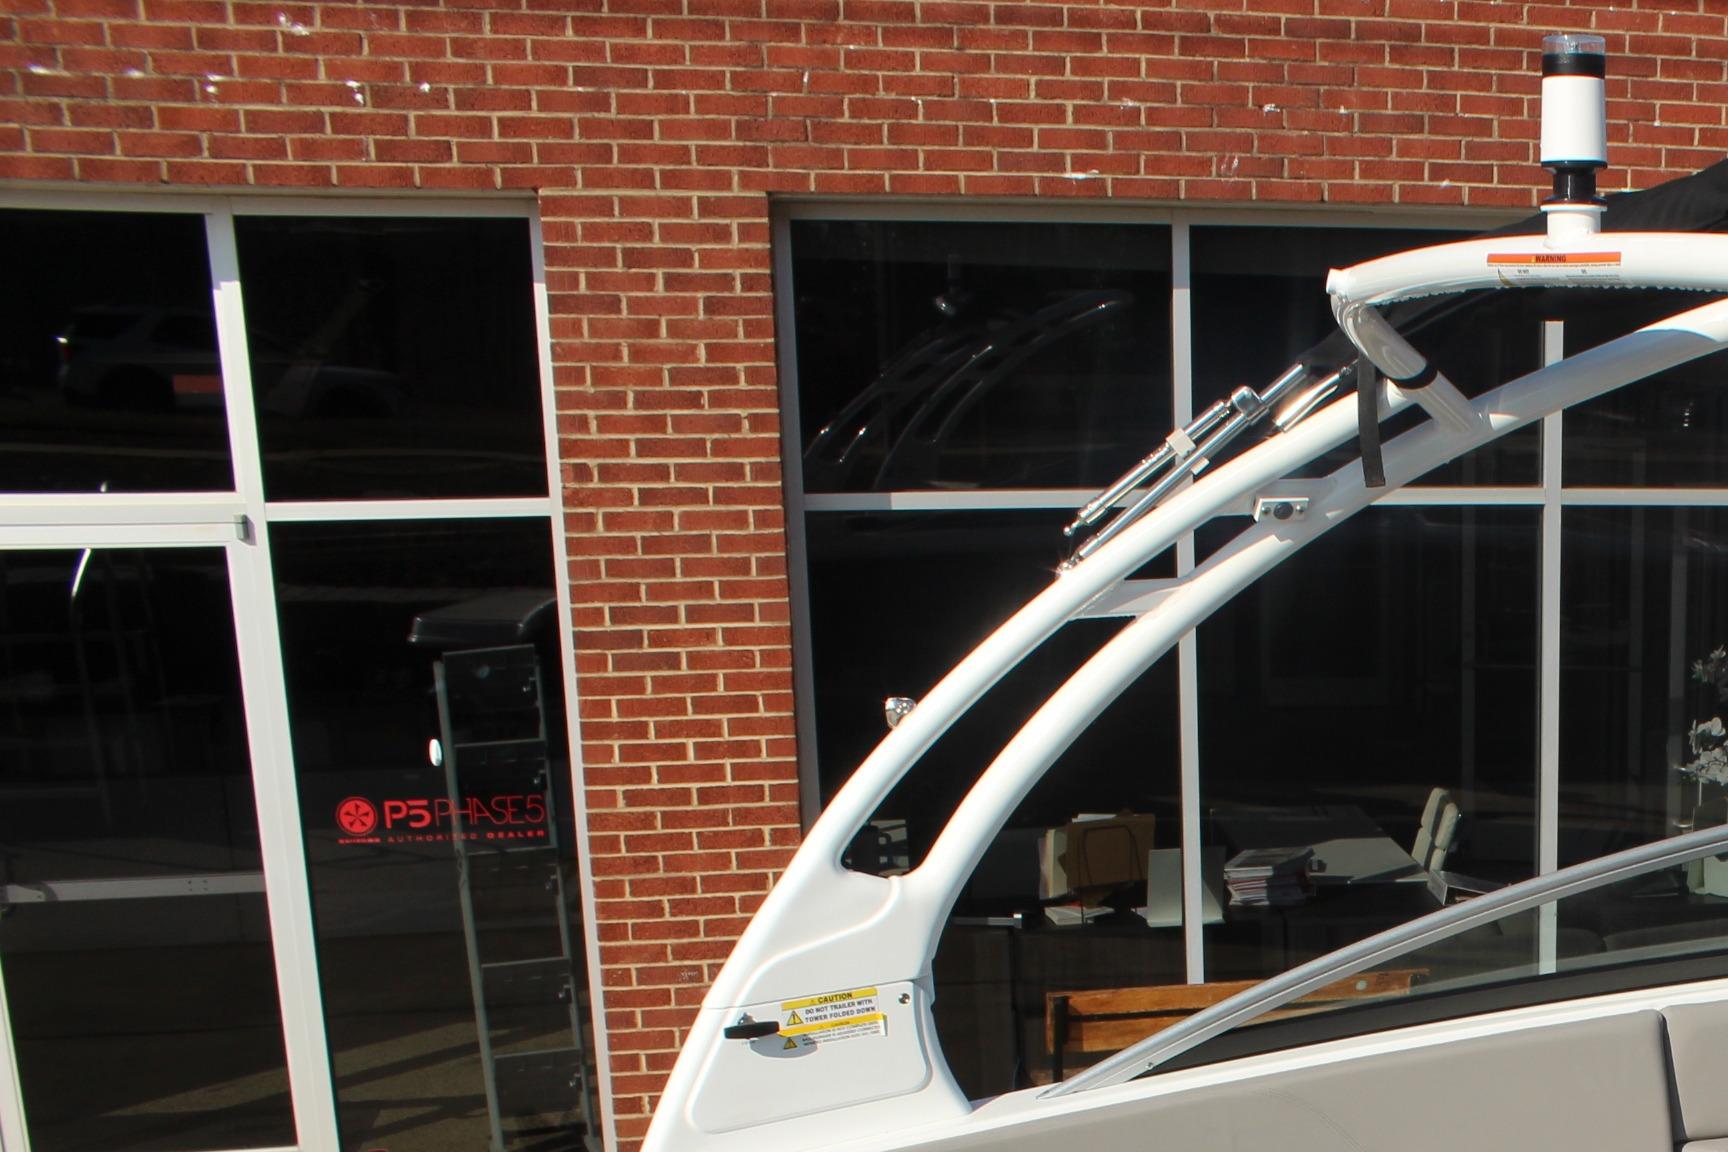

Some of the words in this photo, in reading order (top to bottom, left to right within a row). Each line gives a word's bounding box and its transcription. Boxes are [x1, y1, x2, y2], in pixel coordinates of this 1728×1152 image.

[1535, 255, 1567, 263] WARNING
[486, 829, 546, 840] DEALER
[817, 992, 853, 1004] CAUTION
[815, 1005, 829, 1014] NOT
[830, 1001, 856, 1011] TRAILER
[857, 998, 873, 1006] WITH
[804, 1013, 828, 1023] TOWER
[829, 1009, 855, 1018] FOLDED
[856, 1005, 876, 1014] DOWN
